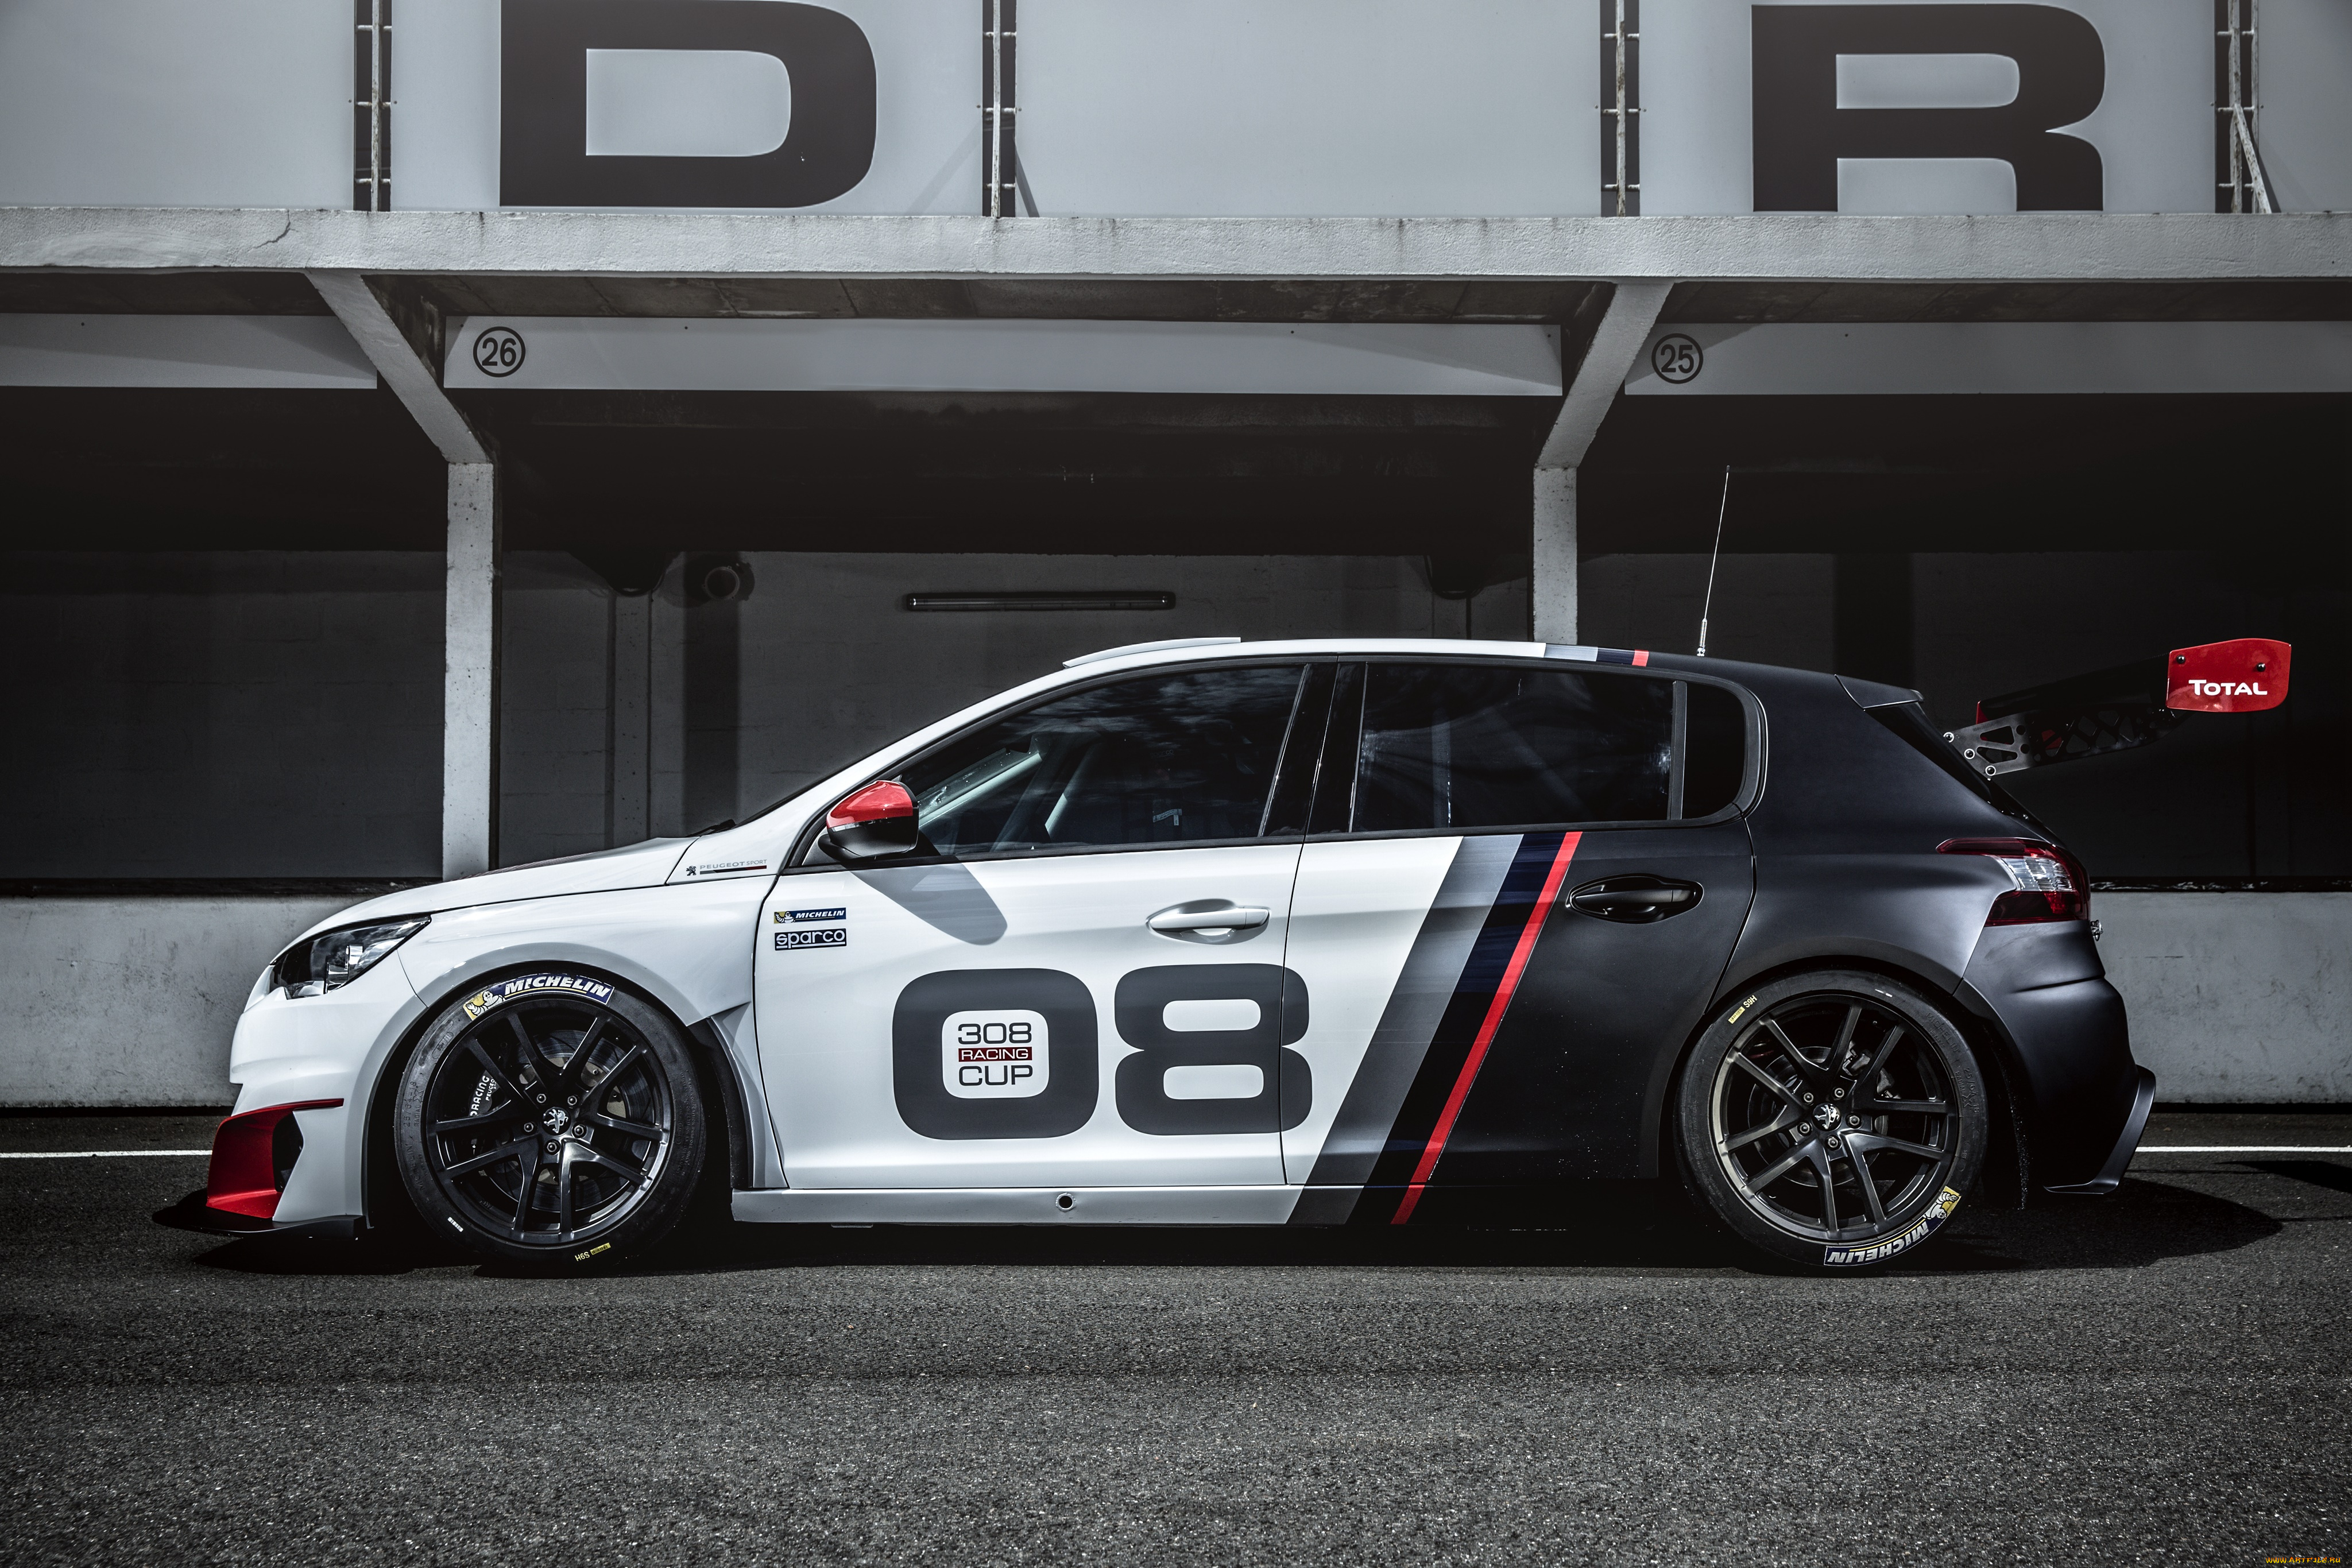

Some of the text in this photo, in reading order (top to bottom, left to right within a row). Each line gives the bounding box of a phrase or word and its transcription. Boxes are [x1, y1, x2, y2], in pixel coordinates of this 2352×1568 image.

[499, 0, 877, 208] D
[1751, 3, 2106, 212] R
[481, 337, 517, 367] 26
[1660, 344, 1695, 375] 25
[2188, 680, 2268, 696] TOTAL
[699, 861, 745, 870] PEUGEOT
[795, 910, 845, 919] MICHELIN
[776, 930, 845, 949] sparco
[504, 975, 611, 998] MICHELIN
[958, 1022, 1032, 1045] 308
[1925, 1013, 1960, 1053] MICHELIN
[892, 963, 1313, 1141] 08
[960, 1048, 1030, 1061] RACING
[958, 1064, 1034, 1086] CUP
[485, 1077, 496, 1101] PEUGEO
[1828, 1221, 1929, 1263] MICHELIN
